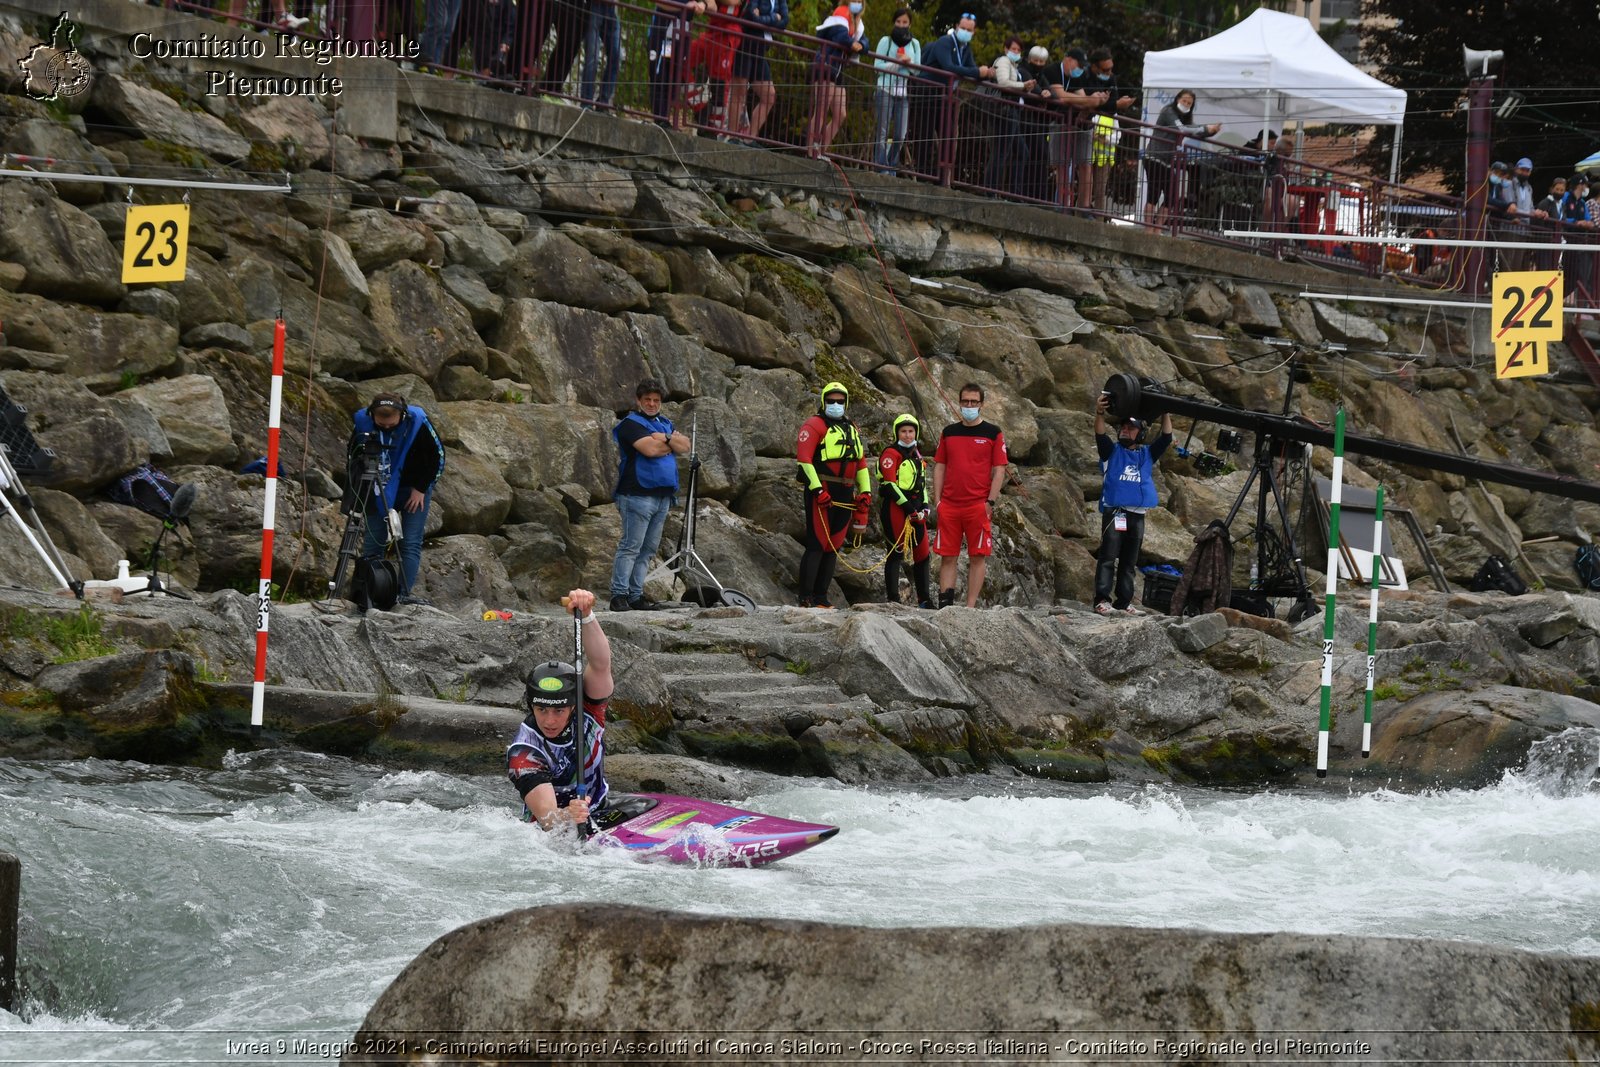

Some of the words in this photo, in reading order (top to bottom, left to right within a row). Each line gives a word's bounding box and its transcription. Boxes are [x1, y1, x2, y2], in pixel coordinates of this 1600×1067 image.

[132, 219, 178, 268] 23
[1501, 286, 1553, 328] 22
[1505, 341, 1538, 367] 21
[258, 597, 270, 613] 23
[532, 697, 568, 705] galasport
